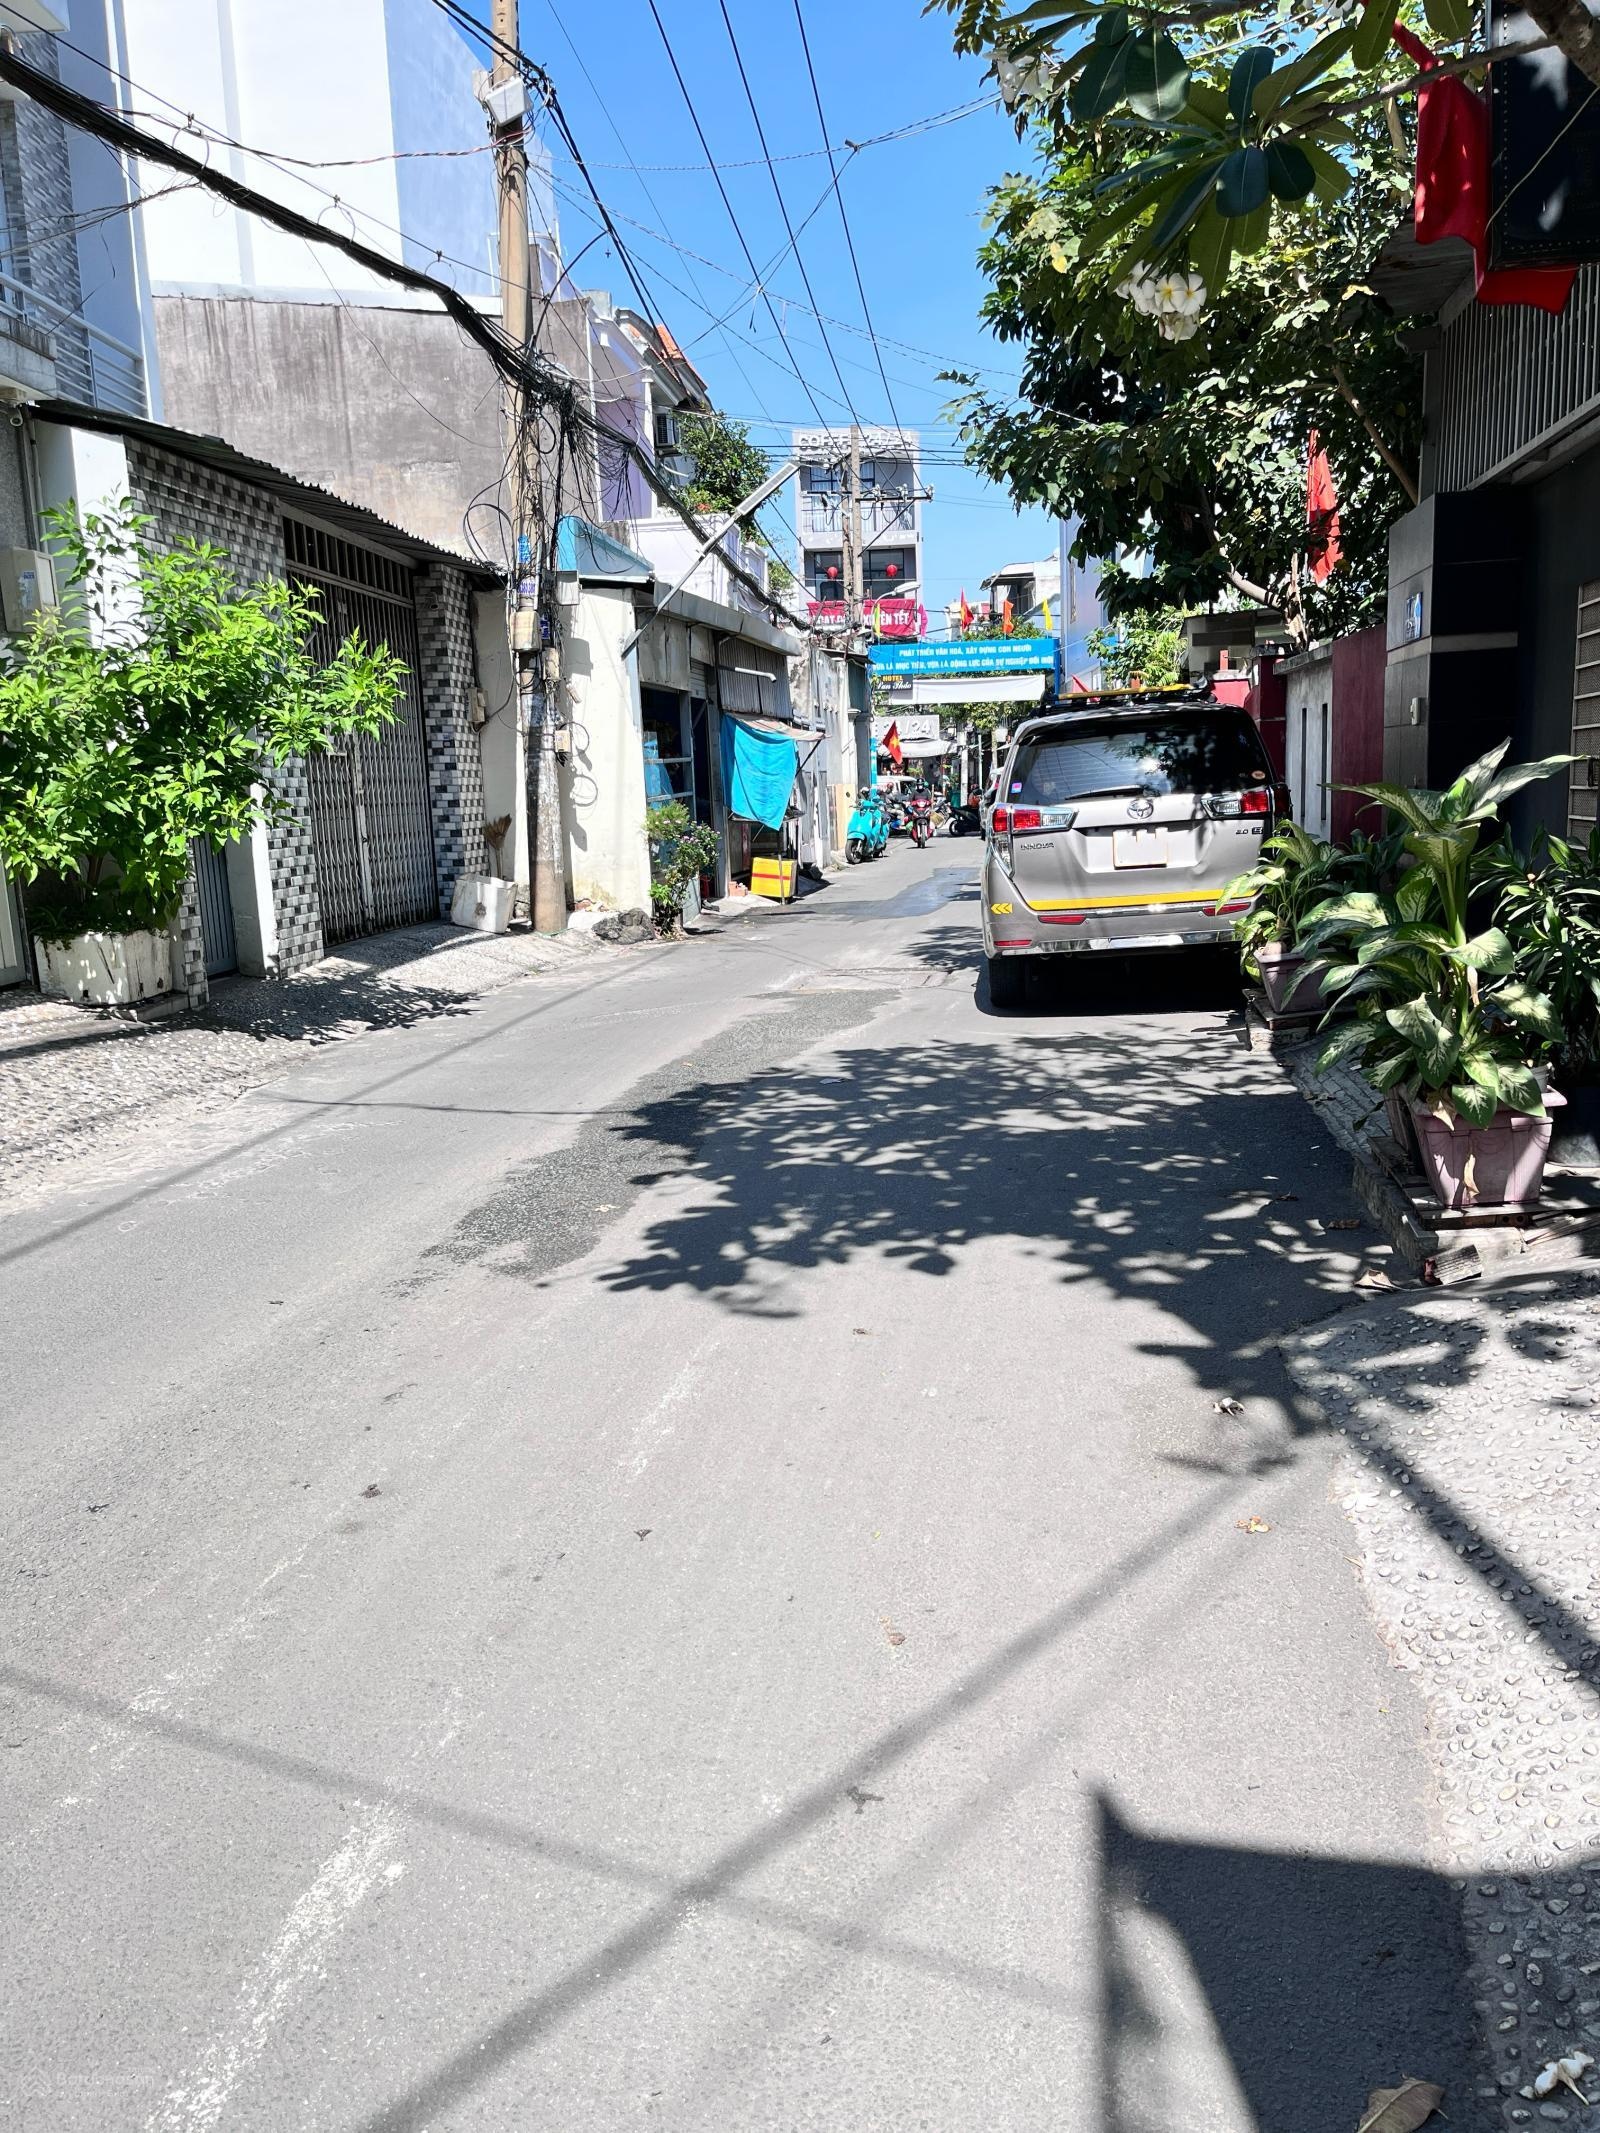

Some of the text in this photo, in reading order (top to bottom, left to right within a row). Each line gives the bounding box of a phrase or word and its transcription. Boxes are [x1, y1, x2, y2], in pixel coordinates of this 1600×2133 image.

[799, 434, 858, 449] COFFE
[894, 609, 909, 625] TẾT
[899, 649, 915, 657] PHÁT
[965, 645, 978, 654] XÂY
[1020, 842, 1055, 851] INNOVA
